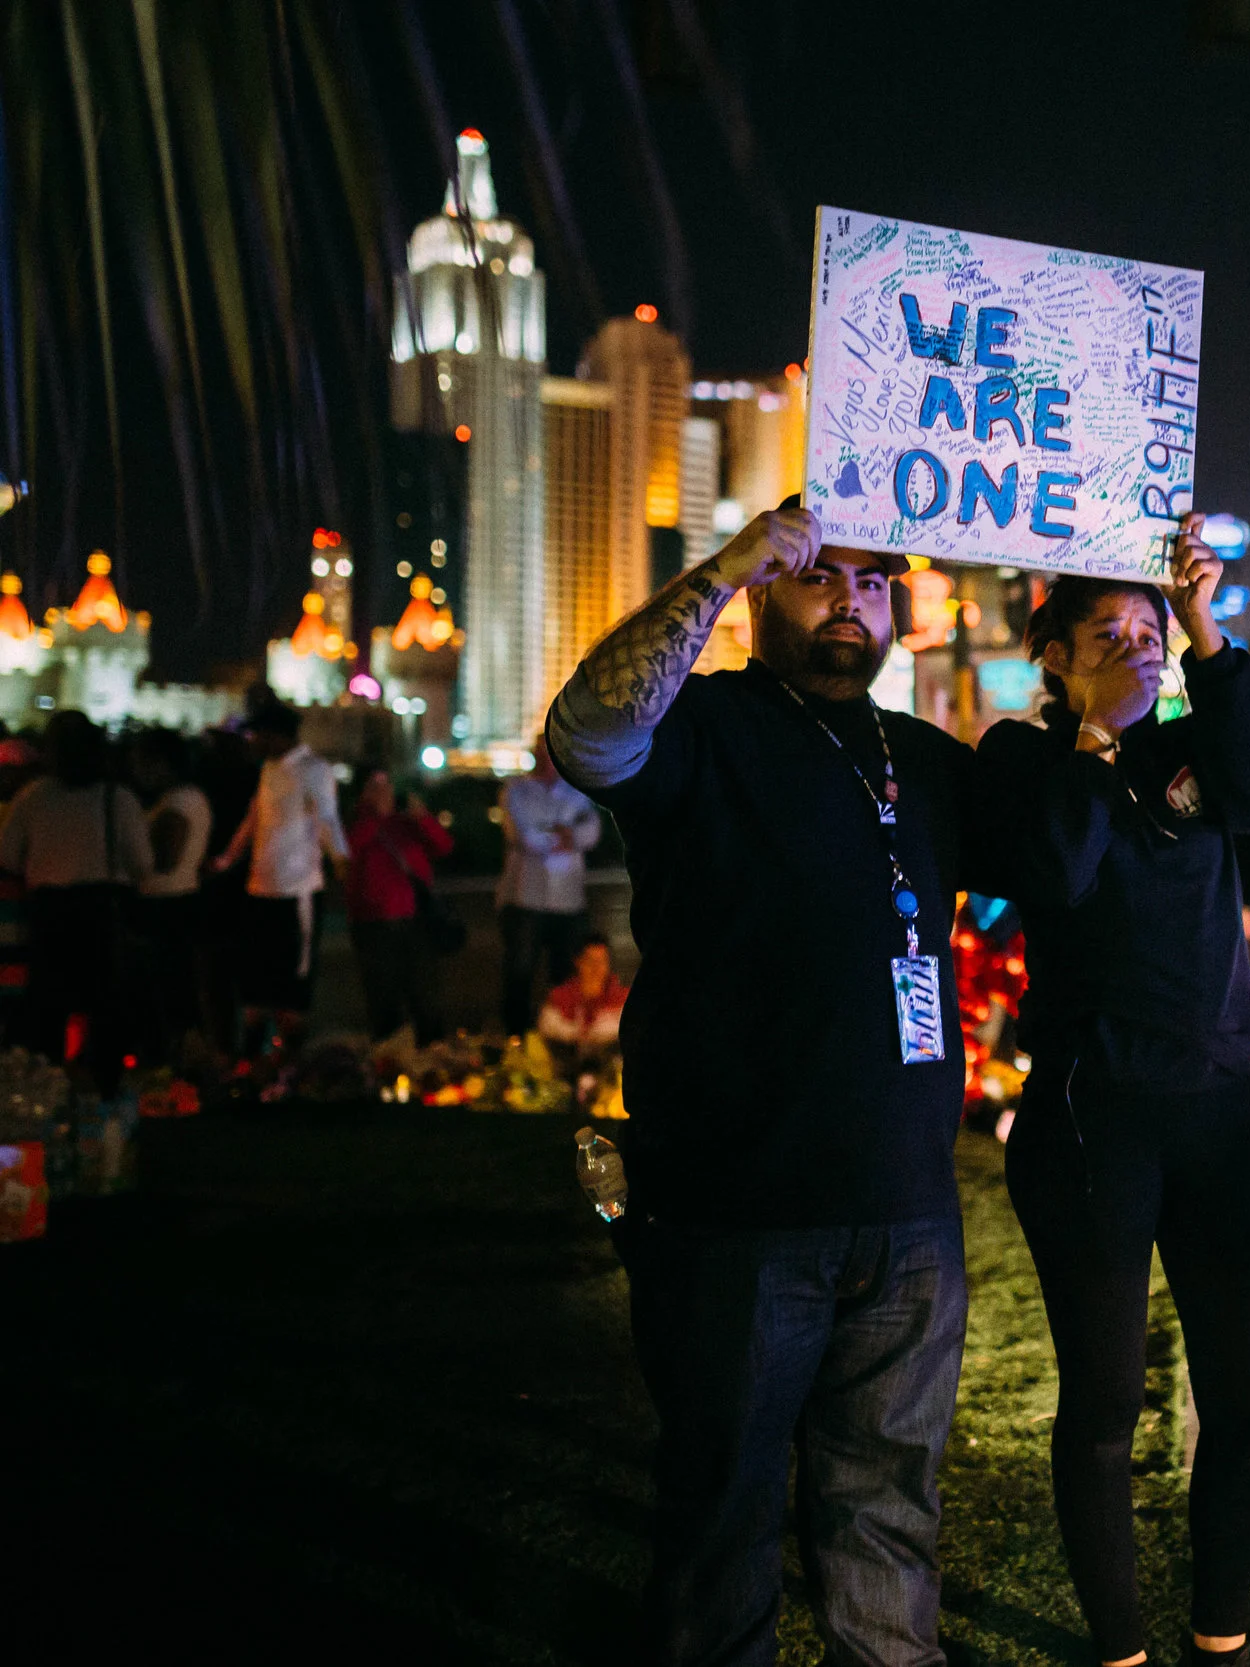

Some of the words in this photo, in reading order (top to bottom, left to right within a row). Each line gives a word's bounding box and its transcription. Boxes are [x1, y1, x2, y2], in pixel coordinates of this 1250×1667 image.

[839, 289, 894, 376] Mexico
[898, 292, 1019, 370] WE
[820, 376, 868, 447] Vegas
[887, 378, 928, 448] you
[917, 373, 1072, 453] ARE
[892, 447, 1082, 539] ONE
